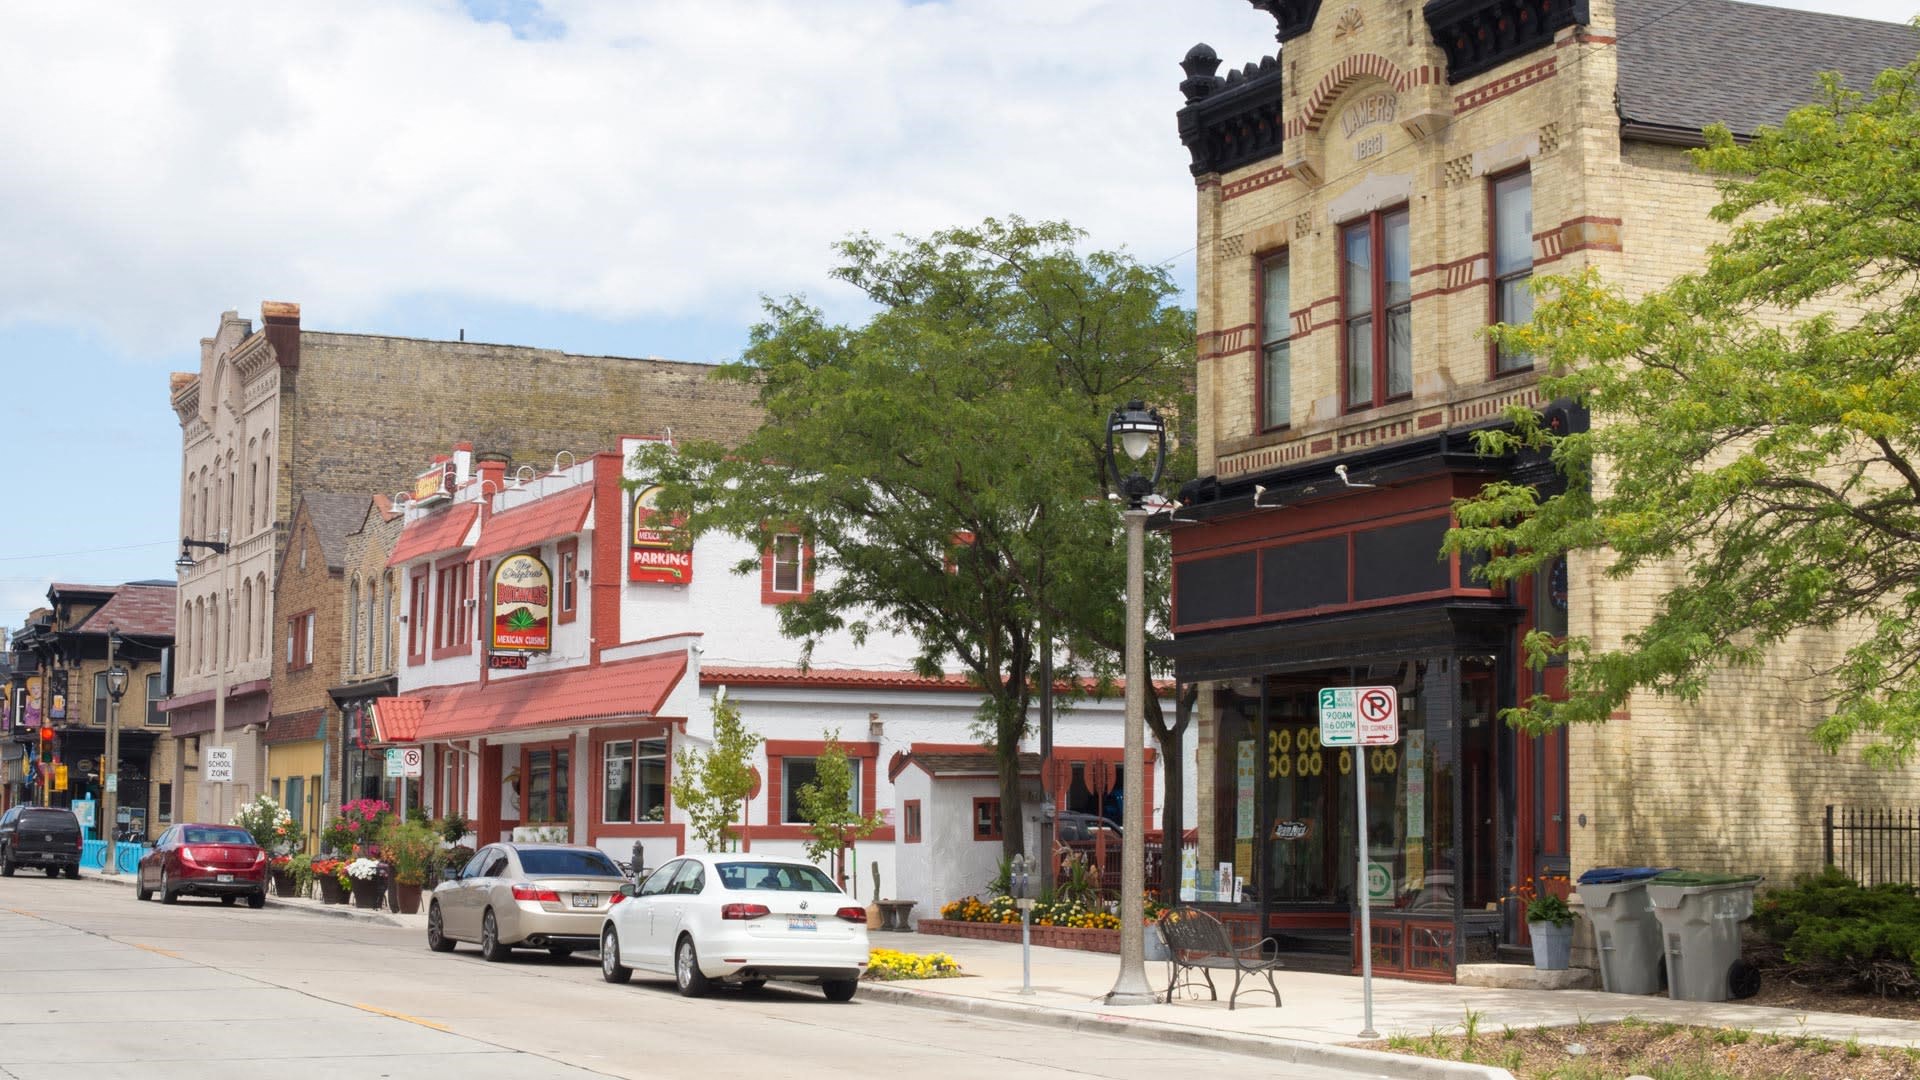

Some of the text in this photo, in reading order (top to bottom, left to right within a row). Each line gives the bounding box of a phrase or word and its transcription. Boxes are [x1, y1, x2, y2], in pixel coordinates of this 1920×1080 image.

[1343, 94, 1396, 139] LAMERS
[514, 559, 531, 569] The
[633, 551, 689, 566] PARKING
[502, 567, 543, 582] Original
[497, 635, 546, 646] MEXICAN CUISINE
[491, 656, 527, 668] OPEN
[1322, 695, 1334, 708] 2
[212, 751, 227, 759] END
[208, 760, 231, 768] SCHOOL
[211, 769, 230, 777] ZONE
